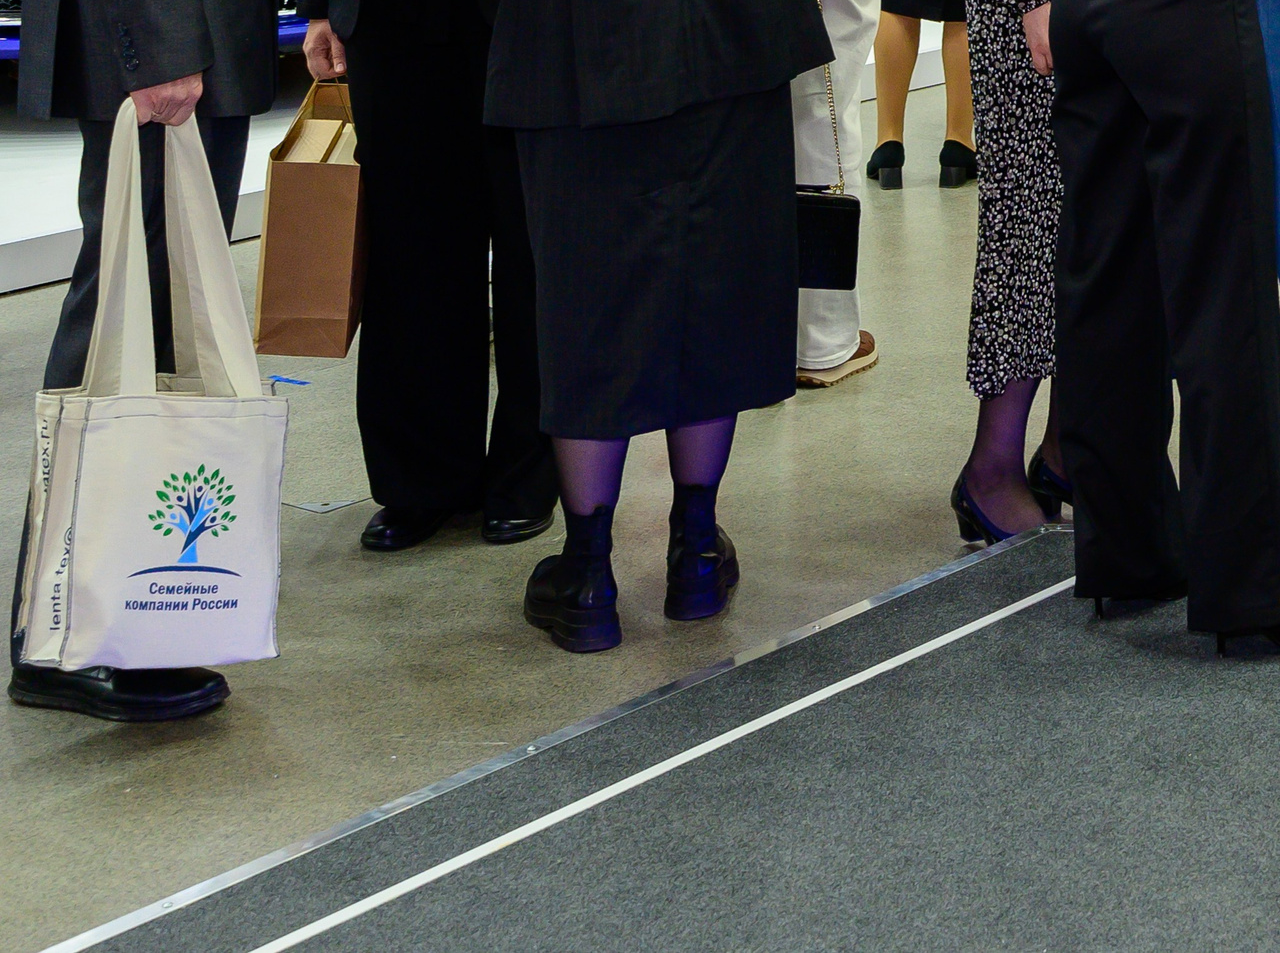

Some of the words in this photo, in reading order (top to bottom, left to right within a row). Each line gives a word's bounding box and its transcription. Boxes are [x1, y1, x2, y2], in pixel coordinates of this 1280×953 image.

[149, 582, 219, 595] Семейные
[125, 599, 189, 611] компании
[192, 598, 238, 611] России
